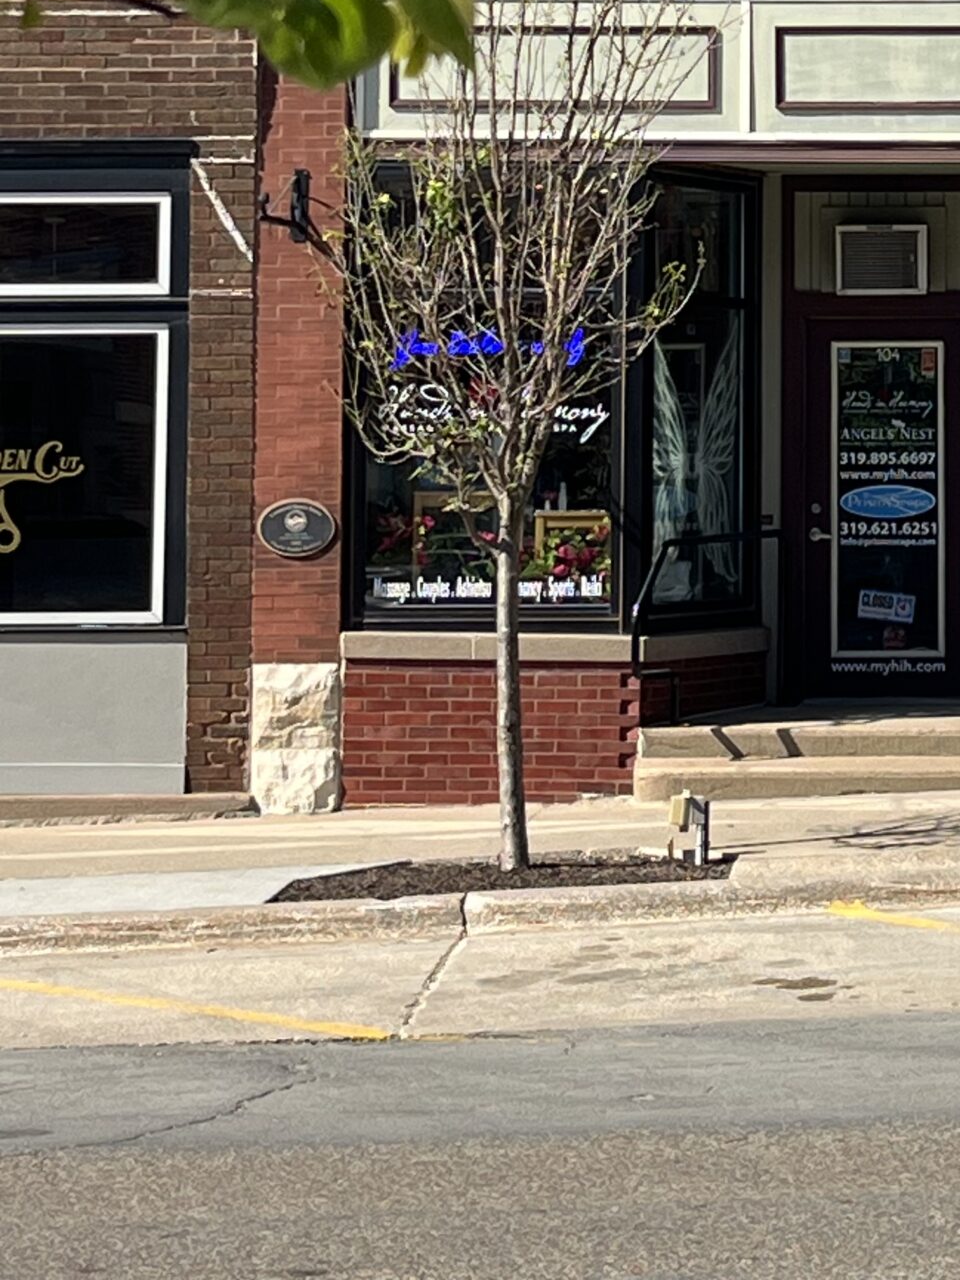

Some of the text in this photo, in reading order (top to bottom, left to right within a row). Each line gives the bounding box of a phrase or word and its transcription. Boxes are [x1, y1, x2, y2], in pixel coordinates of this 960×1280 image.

[875, 348, 900, 362] 104
[899, 426, 936, 440] NEST
[840, 452, 936, 465] 319.895.6697
[840, 522, 937, 535] 319.621.6251
[831, 659, 946, 676] www.myhih.com
